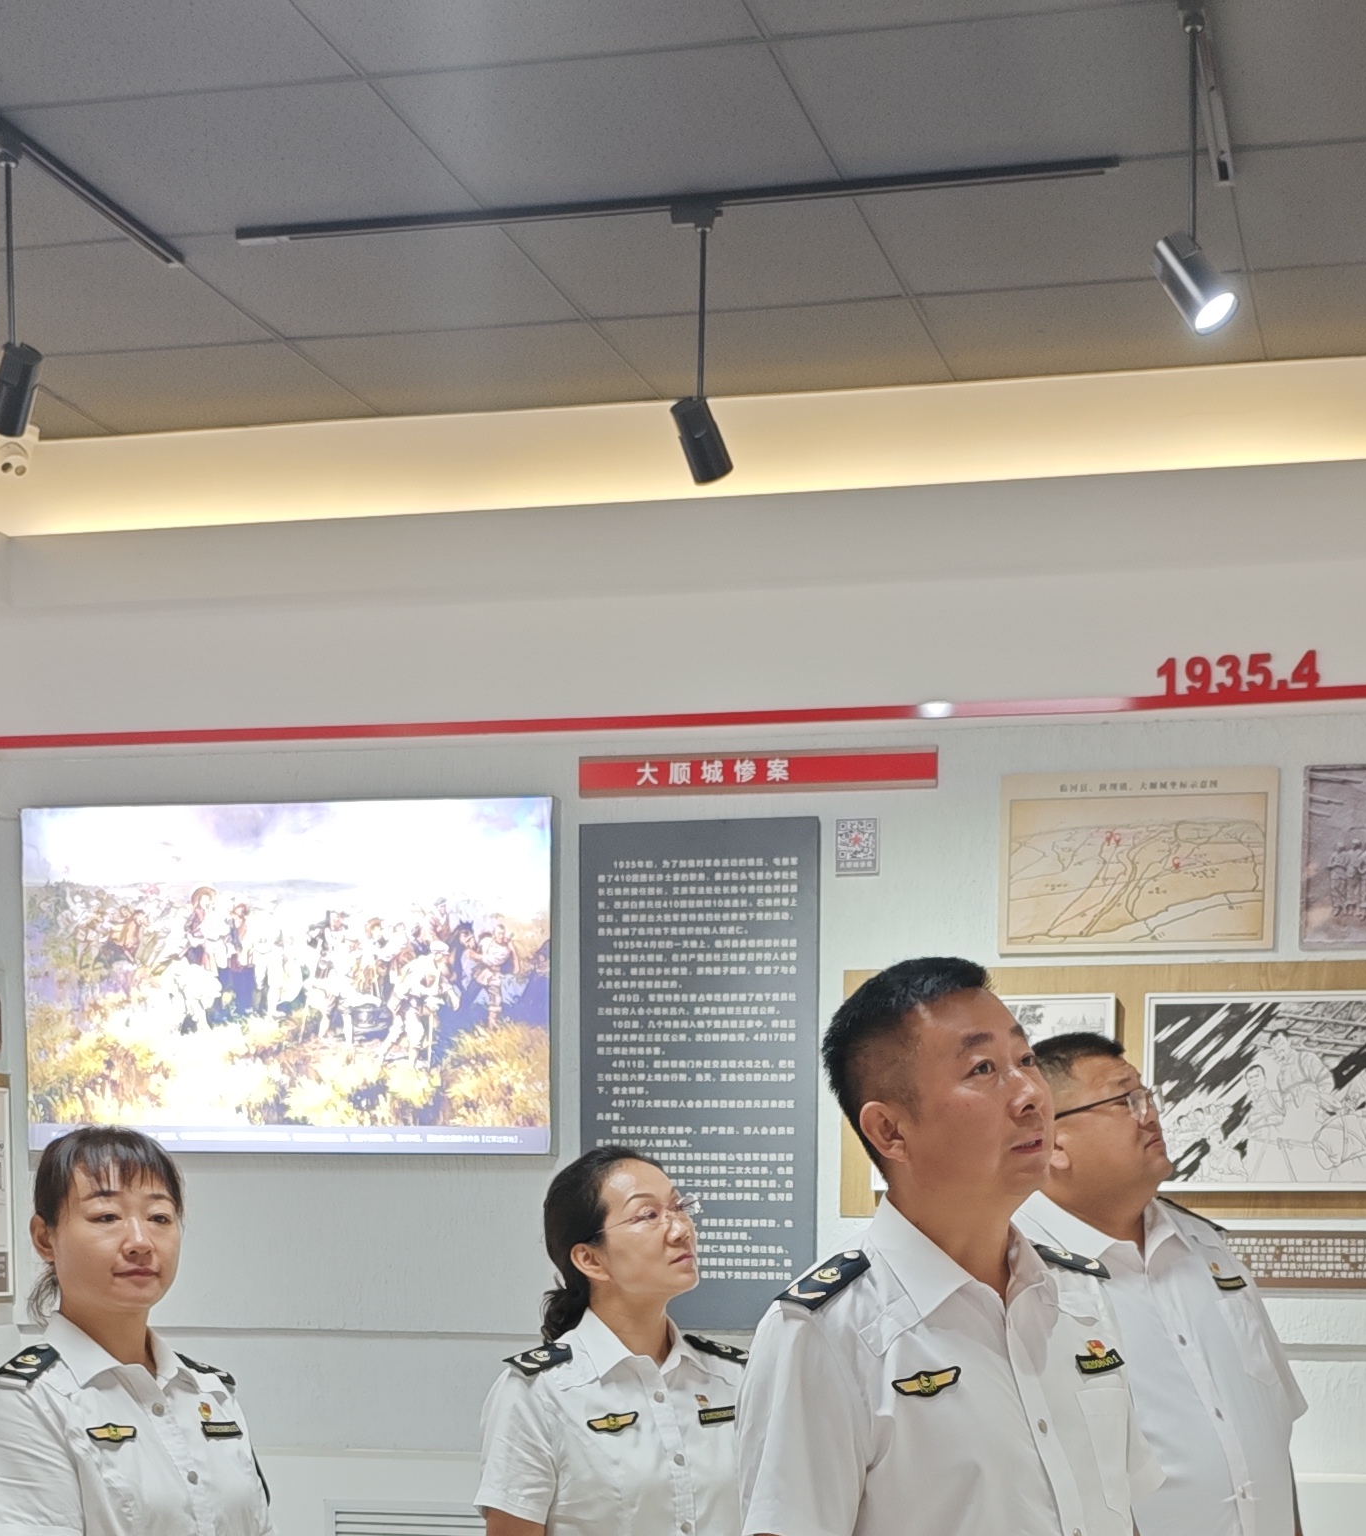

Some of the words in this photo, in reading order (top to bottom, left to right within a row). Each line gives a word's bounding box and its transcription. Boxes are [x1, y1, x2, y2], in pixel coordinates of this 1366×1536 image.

[1156, 650, 1321, 695] 1935.4
[636, 759, 790, 785] 大顺城惨案
